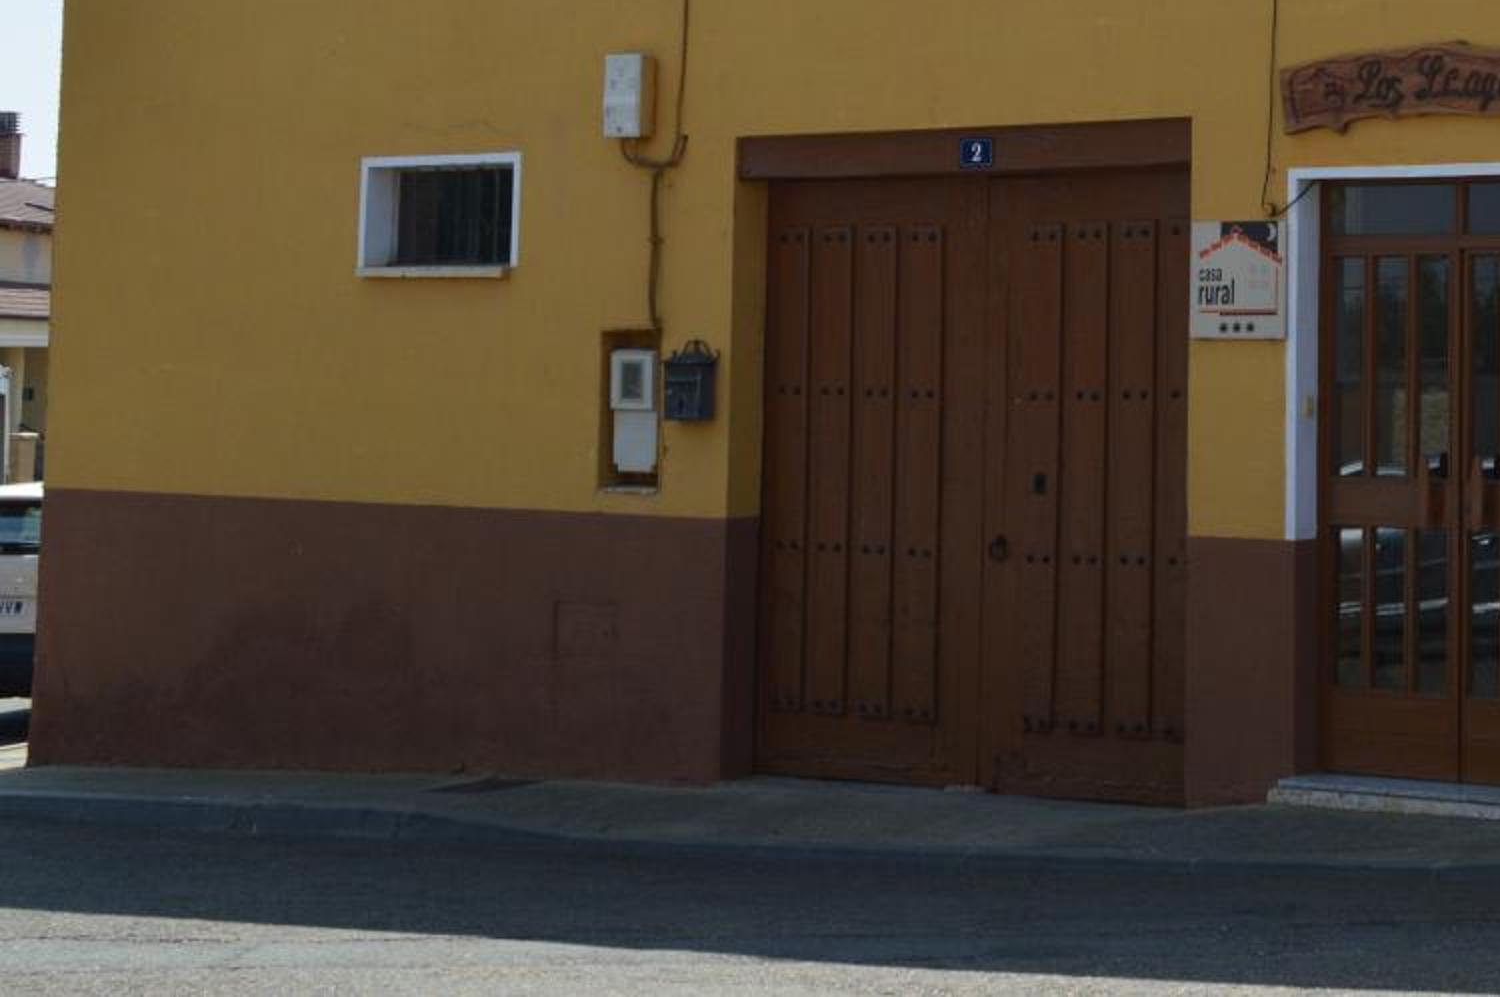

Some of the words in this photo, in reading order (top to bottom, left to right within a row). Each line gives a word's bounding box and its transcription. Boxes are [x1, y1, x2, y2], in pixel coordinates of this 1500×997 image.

[1353, 60, 1404, 108] Los
[971, 142, 982, 162] 2
[1199, 267, 1223, 282] casa
[1198, 278, 1235, 305] rural
